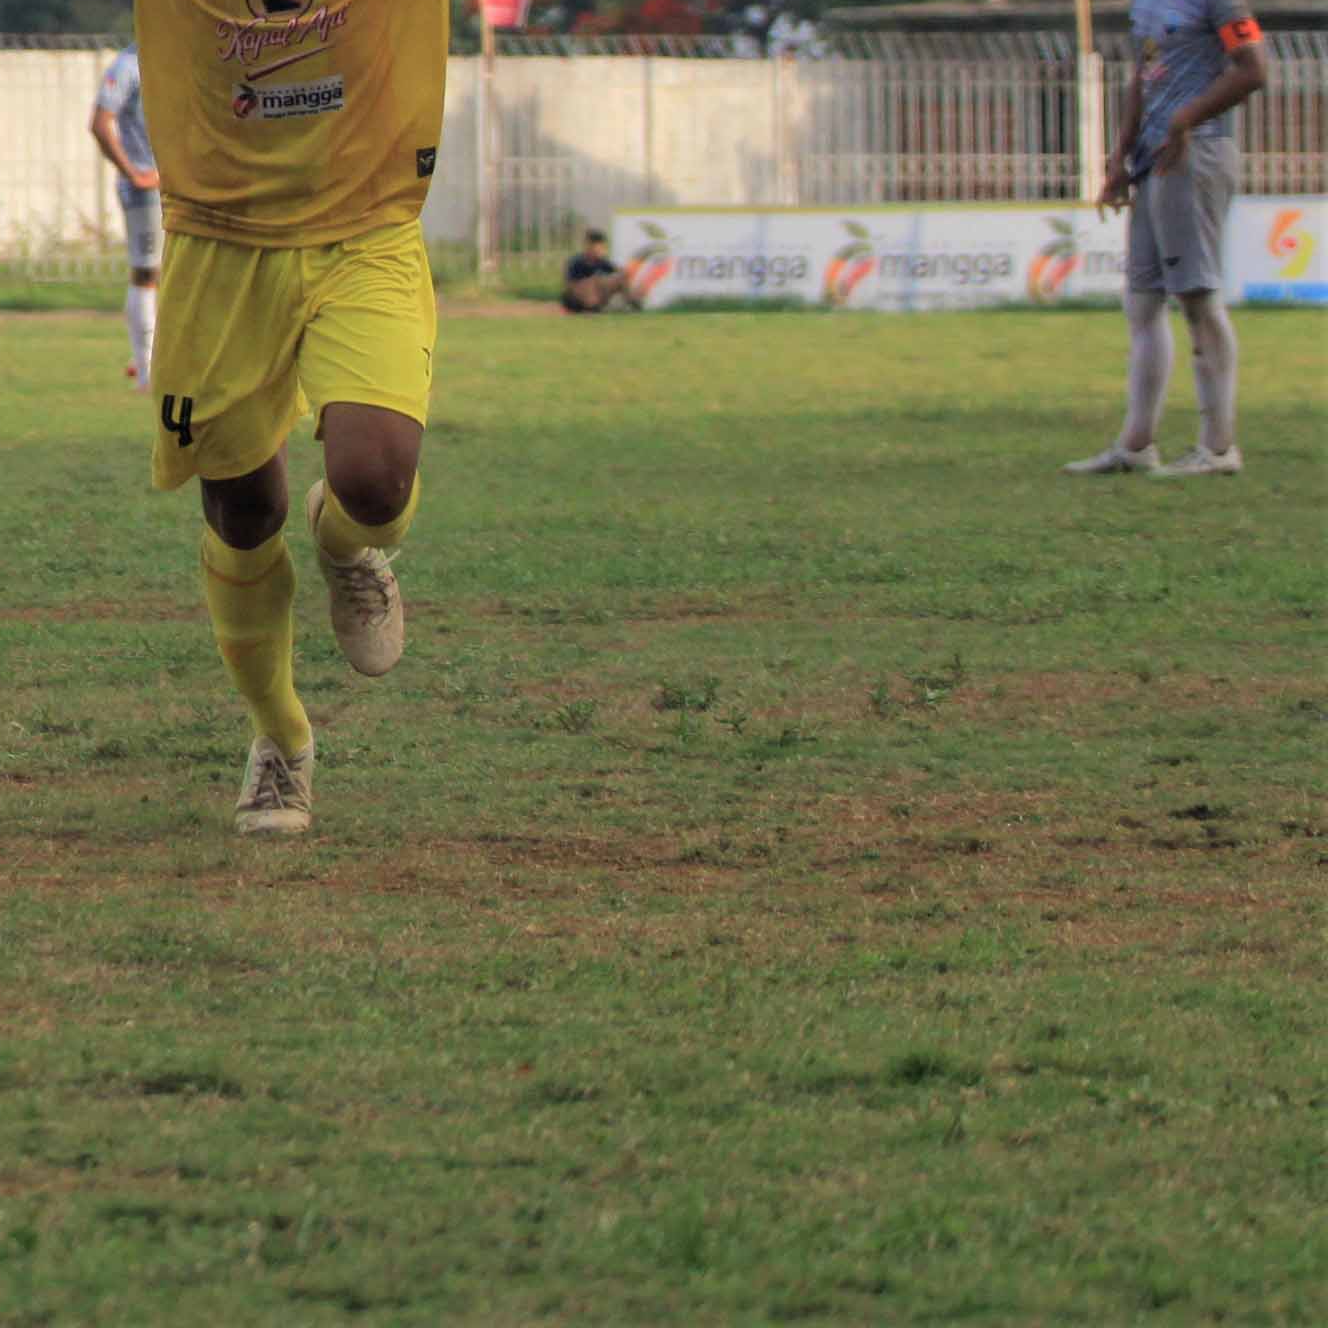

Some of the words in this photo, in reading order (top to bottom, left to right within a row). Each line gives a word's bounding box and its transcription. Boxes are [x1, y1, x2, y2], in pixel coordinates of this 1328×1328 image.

[263, 87, 343, 109] mangga
[677, 254, 808, 286] mangga
[879, 253, 1012, 285] mangga
[161, 394, 193, 448] 4
